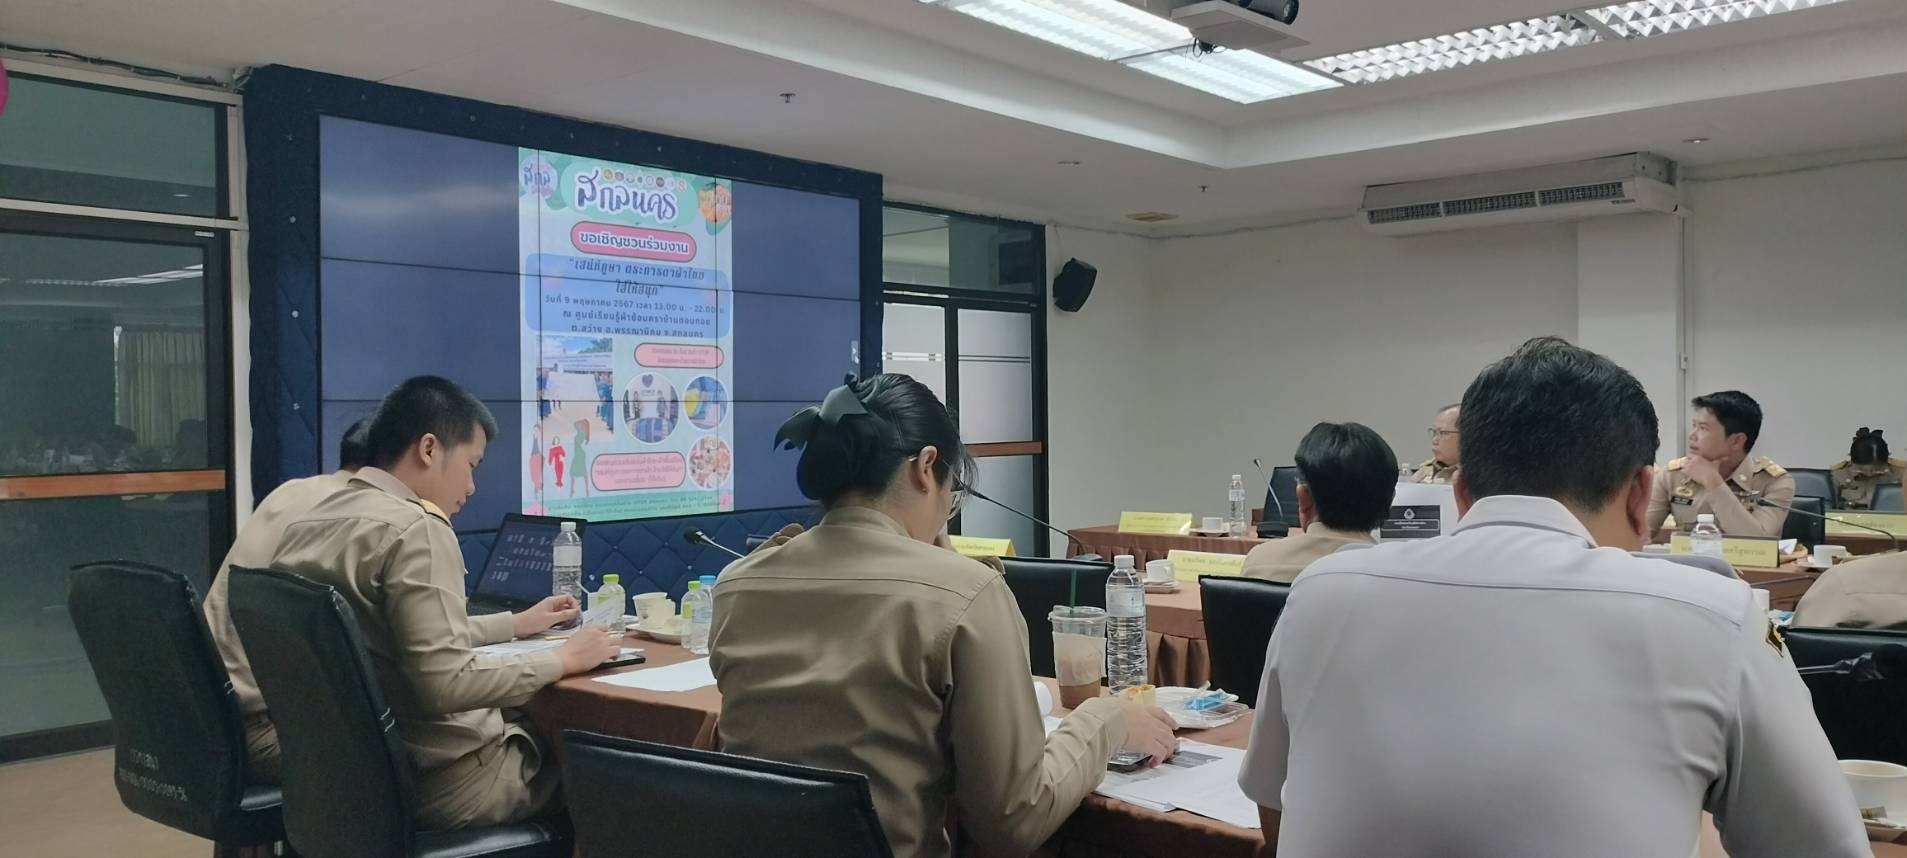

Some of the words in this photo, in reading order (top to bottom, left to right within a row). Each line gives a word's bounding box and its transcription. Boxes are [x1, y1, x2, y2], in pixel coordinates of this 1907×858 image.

[577, 169, 676, 221] สกลนคร
[580, 232, 689, 254] ขอเชิญชวนร่วมงาน
